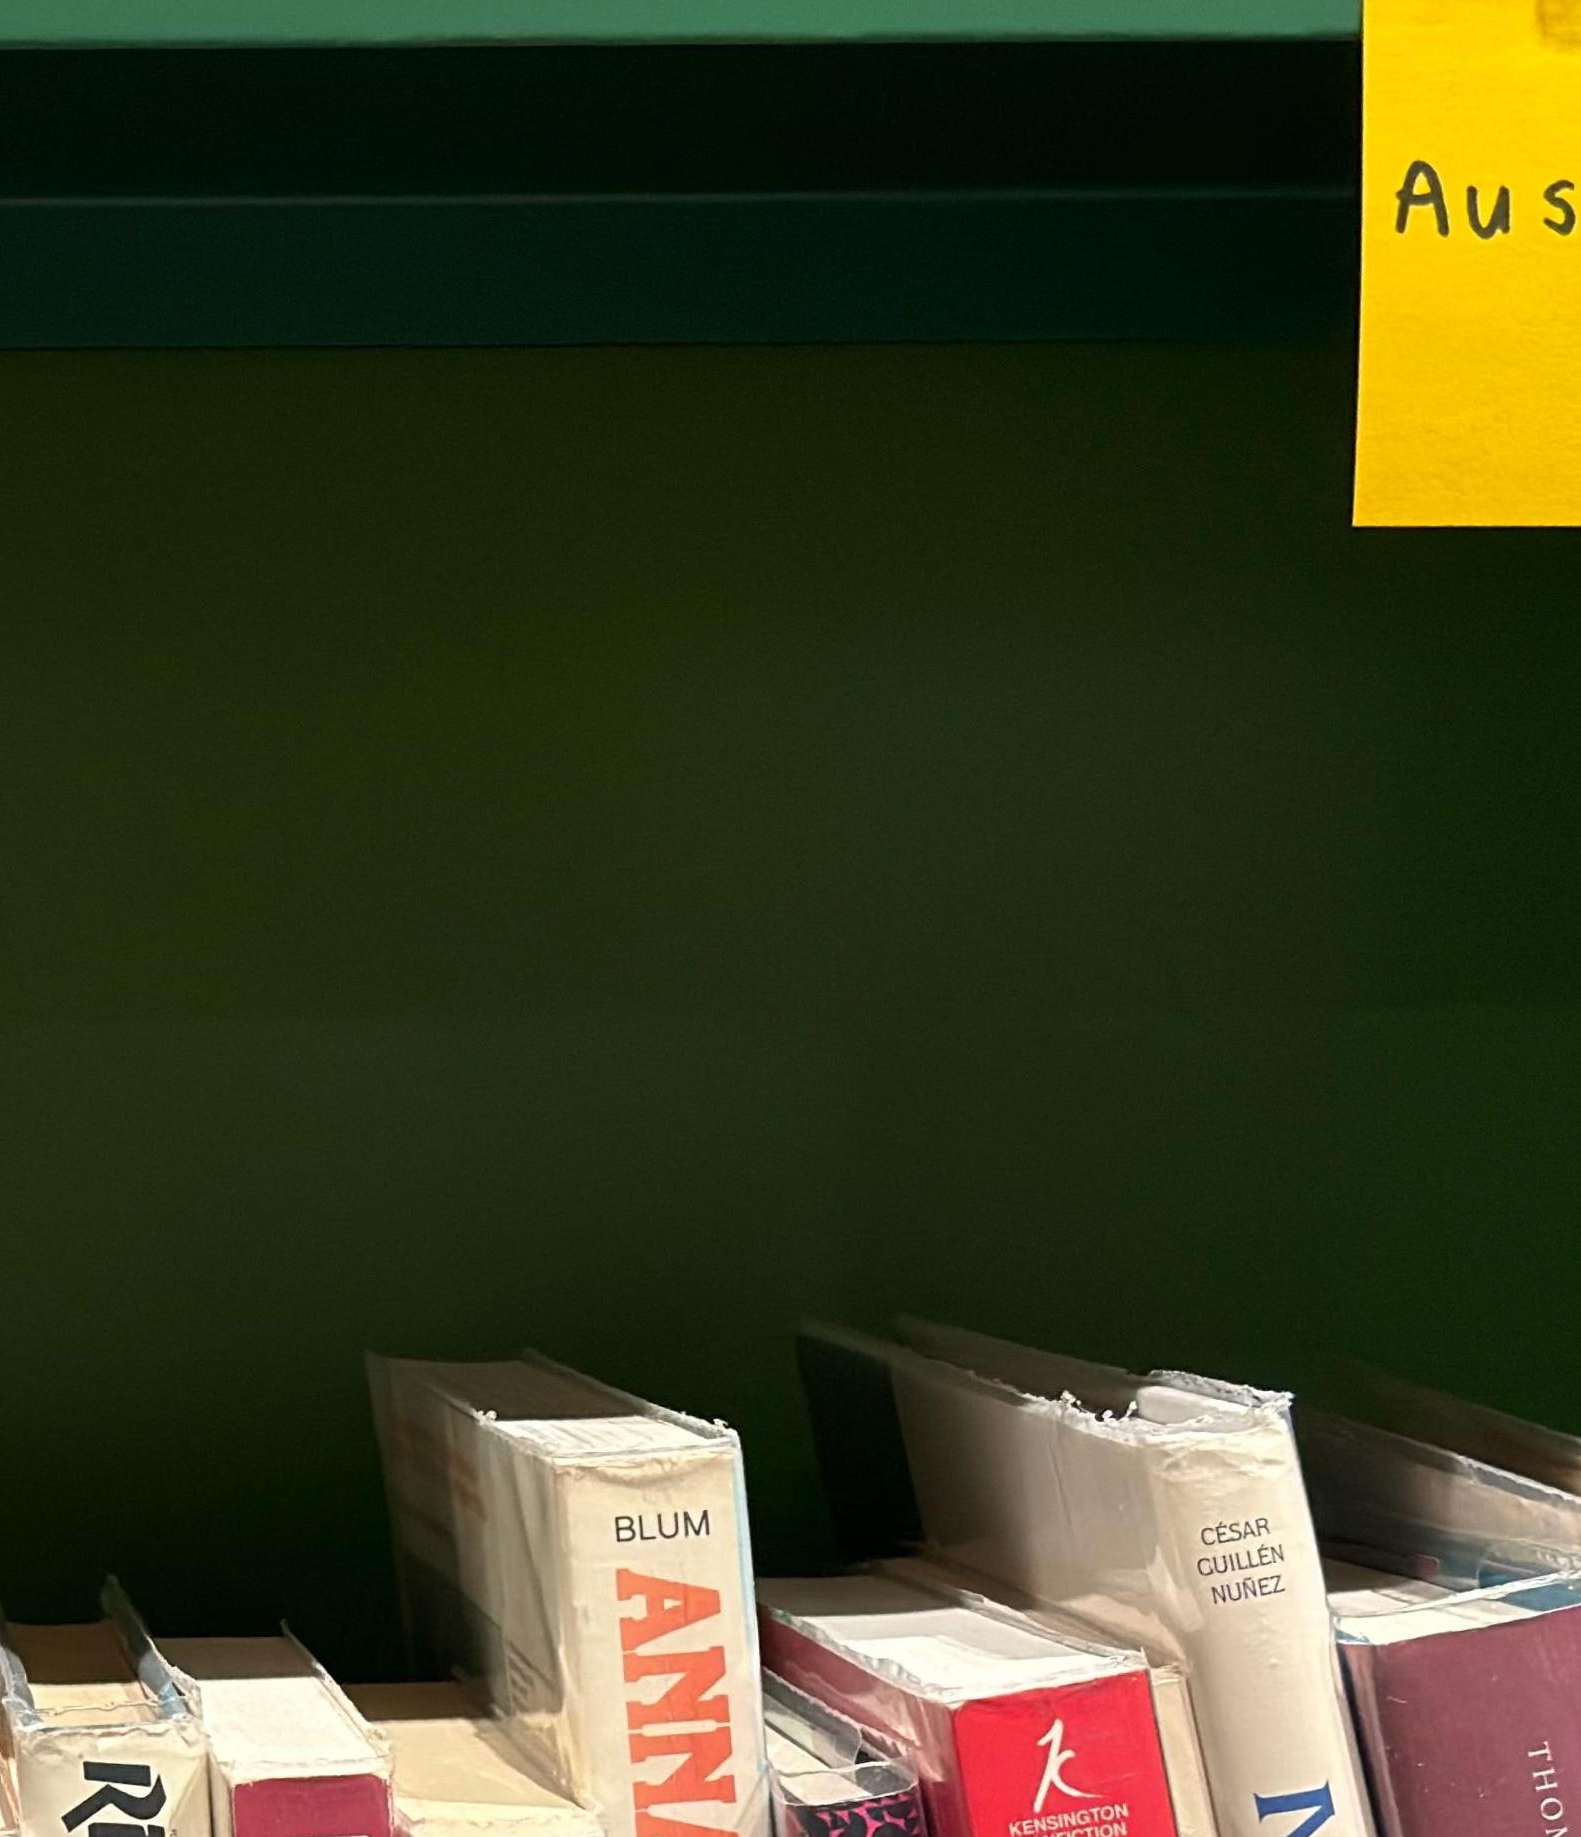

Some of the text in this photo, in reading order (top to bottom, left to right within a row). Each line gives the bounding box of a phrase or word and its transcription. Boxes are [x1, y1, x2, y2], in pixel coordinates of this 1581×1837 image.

[614, 1510, 712, 1543] BLUM
[1197, 1545, 1285, 1576] GUILLÉN
[1009, 1803, 1129, 1837] KENSINGTON
